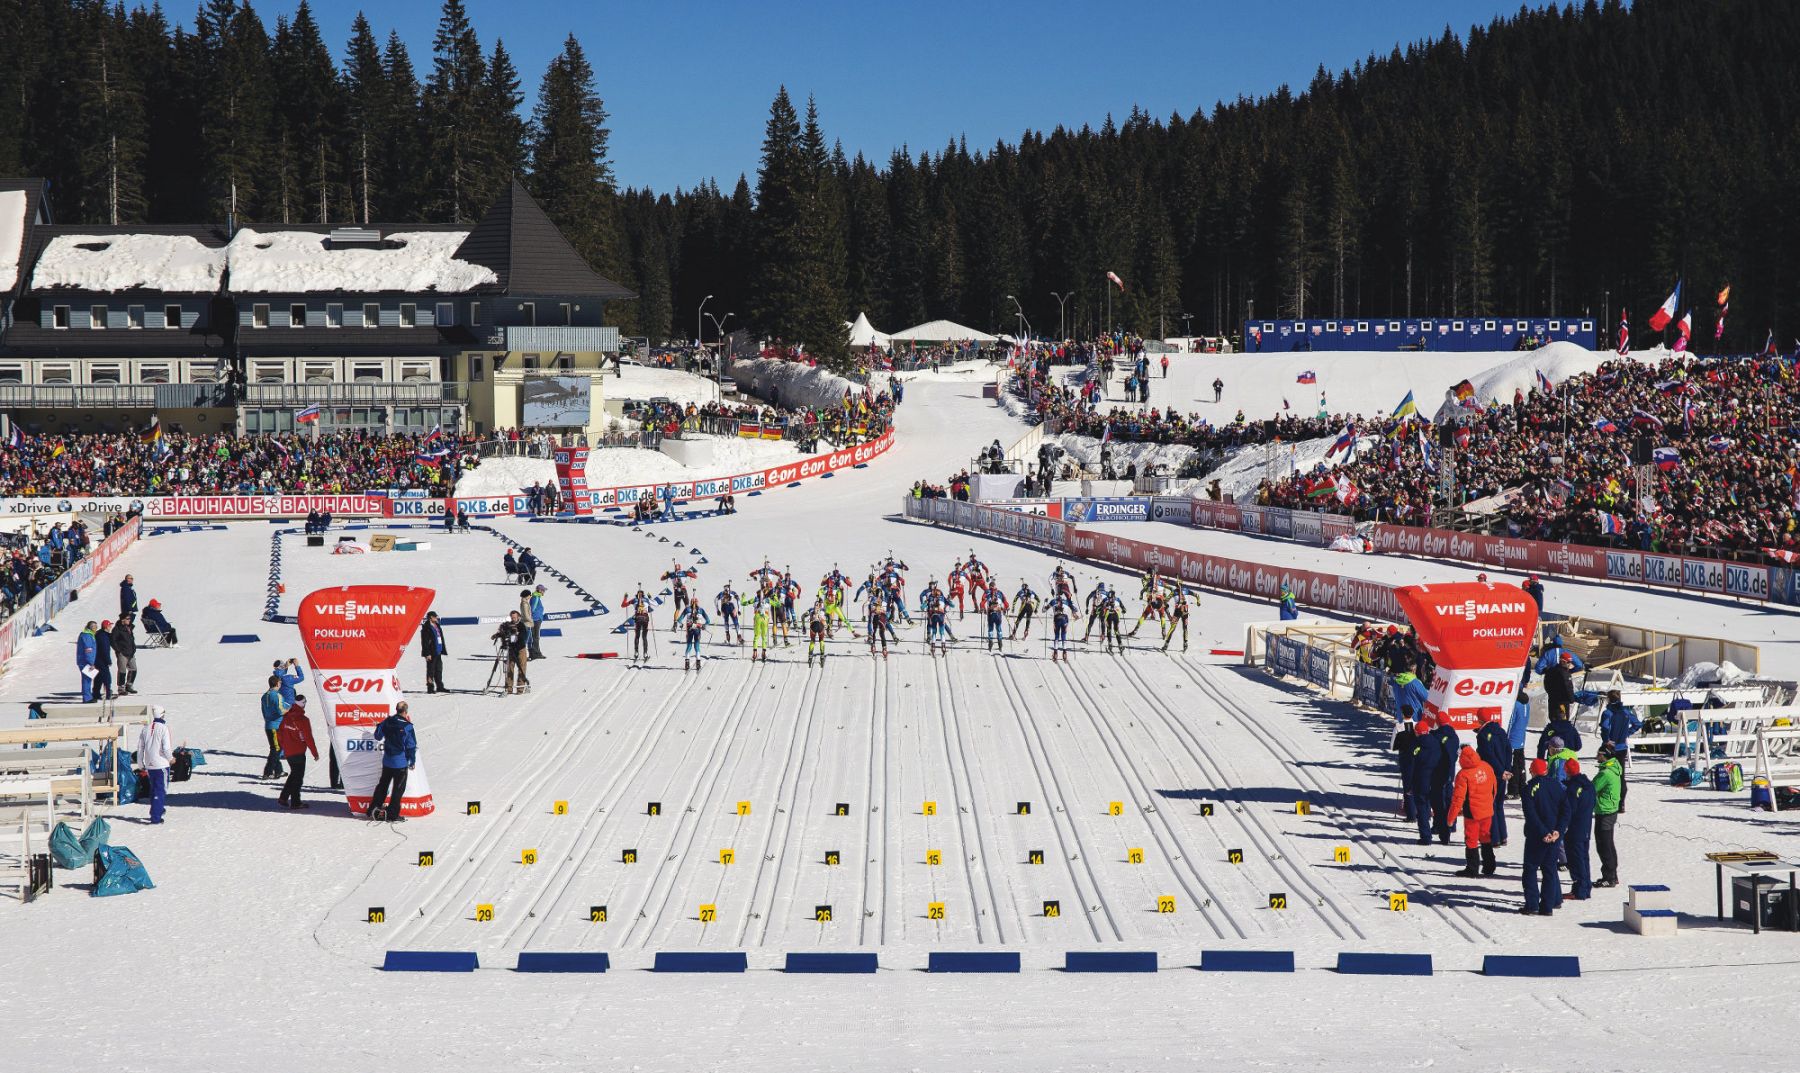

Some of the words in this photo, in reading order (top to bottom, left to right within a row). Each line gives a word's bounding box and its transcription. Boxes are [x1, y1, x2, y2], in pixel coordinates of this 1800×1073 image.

[695, 481, 729, 496] DKB.de
[732, 476, 765, 490] DKB.de
[617, 488, 654, 503] DKB.de
[10, 503, 52, 513] xDrive
[81, 502, 122, 513] xDrive
[164, 499, 263, 513] BAUHAUS
[282, 499, 380, 512] BAUHAUS
[393, 501, 445, 514] DKB.de
[457, 500, 509, 513] DKB.de
[1096, 504, 1147, 515] ERDINGER
[1485, 540, 1528, 566] VIESSMANN
[1548, 545, 1594, 573] VIESSMANN
[1607, 554, 1642, 577] DKB.de
[1645, 558, 1680, 583] DKB.de
[1683, 562, 1723, 587] DKB.de
[1726, 567, 1767, 594] DKB.de
[315, 600, 406, 621] VIESSMANN
[1435, 600, 1526, 621] VIESSMANN
[314, 629, 366, 638] POKLJUKA
[1473, 627, 1524, 638] POKLJUKA
[315, 642, 344, 651] START
[336, 709, 388, 721] VIESSMANN
[469, 804, 479, 815] 10
[558, 805, 564, 815] 9
[650, 805, 657, 815] 8
[741, 804, 748, 815] 7
[838, 807, 845, 816] 6
[926, 805, 933, 816] 5
[1020, 806, 1028, 816] 4
[1114, 806, 1120, 816] 3
[1203, 807, 1211, 816] 2
[419, 855, 433, 867] 20
[524, 854, 535, 865] 19
[623, 853, 635, 864] 18
[722, 853, 732, 865] 17
[826, 854, 838, 865] 16
[929, 854, 939, 865] 15
[1030, 854, 1043, 865] 14
[1131, 853, 1141, 864] 13
[1230, 852, 1242, 865] 12
[1338, 851, 1347, 862] 11
[1161, 900, 1175, 913] 23
[1270, 897, 1286, 910] 22
[1394, 899, 1405, 912] 21
[369, 911, 384, 924] 30
[478, 909, 491, 922] 29
[591, 910, 606, 923] 28
[701, 909, 714, 922] 27
[816, 909, 832, 923] 26
[931, 907, 943, 920] 25
[1045, 904, 1059, 918] 24
